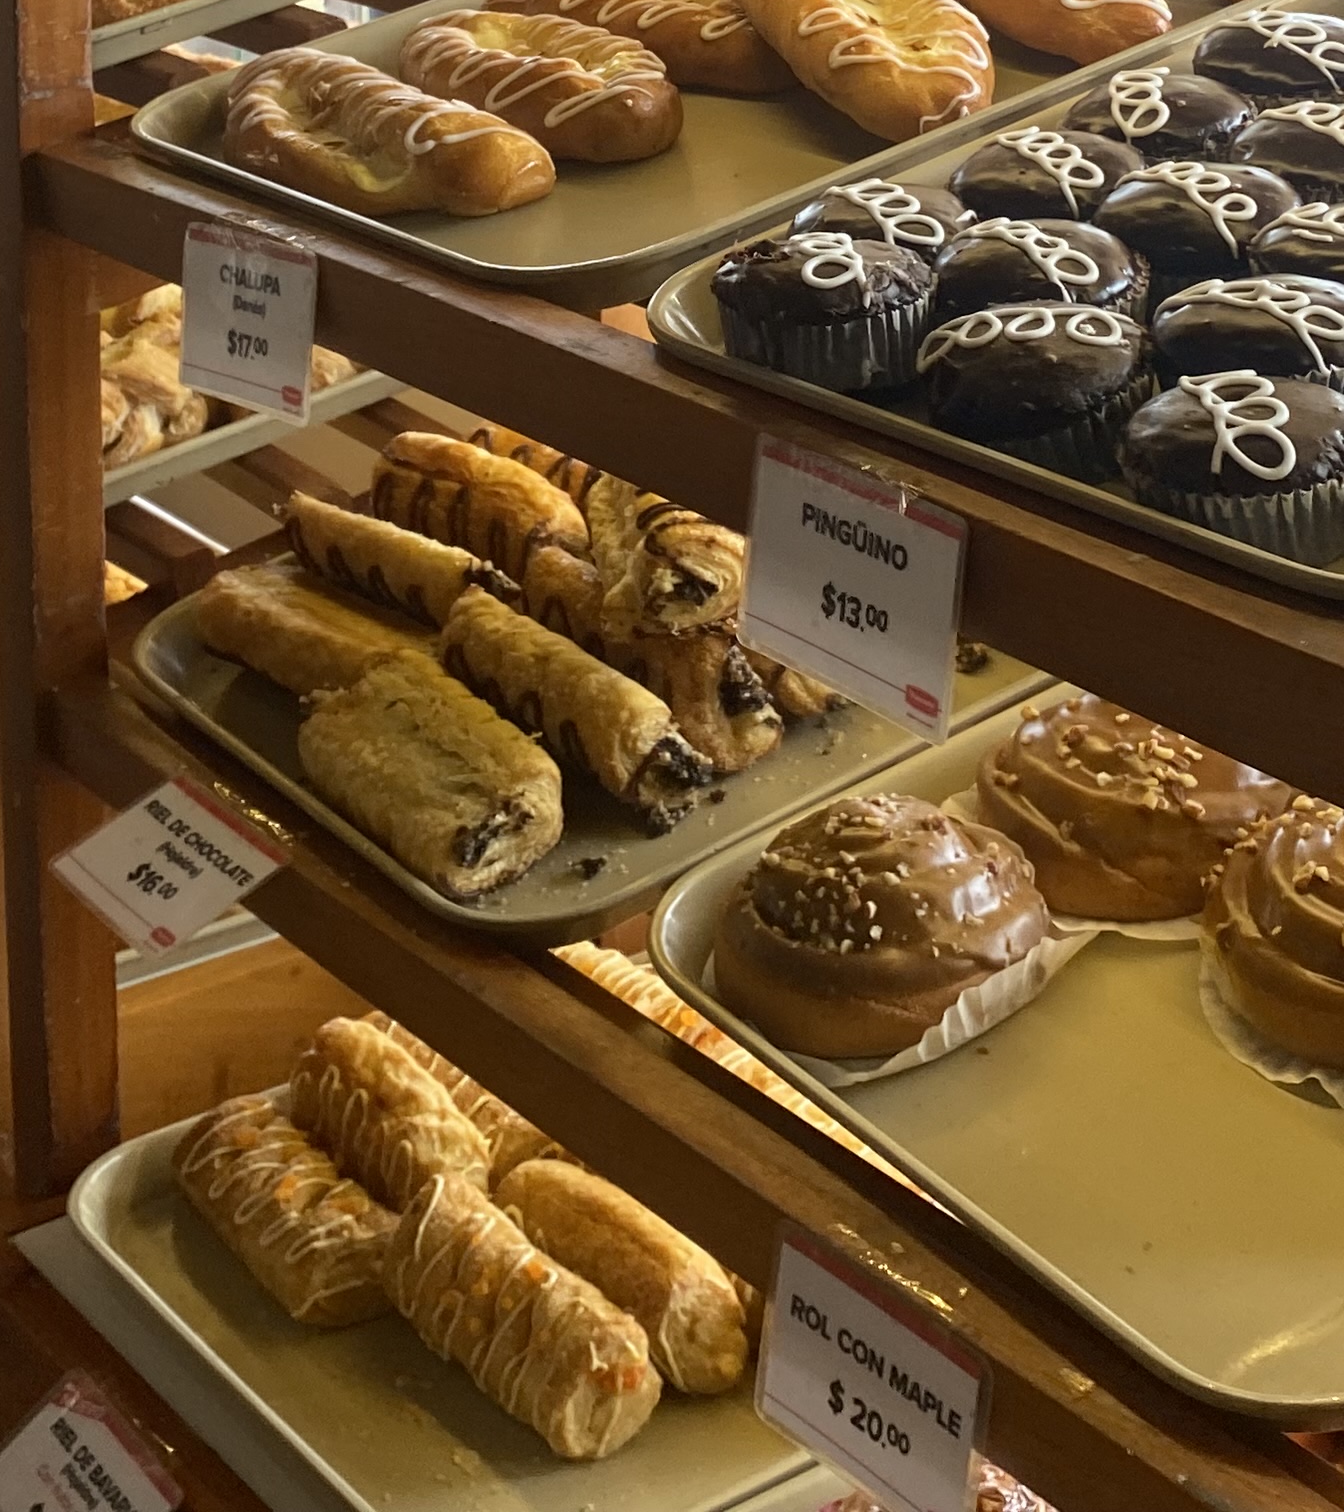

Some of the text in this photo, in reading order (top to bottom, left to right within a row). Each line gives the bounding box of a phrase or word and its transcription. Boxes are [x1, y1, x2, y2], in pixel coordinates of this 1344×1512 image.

[219, 263, 281, 297] CHALUPA
[801, 501, 908, 572] PINGÜINO
[820, 580, 890, 633] $13.00
[143, 799, 256, 888] RIEL DE CHOCOLATE
[790, 1293, 963, 1440] ROL CON MAPLE
[88, 1463, 138, 1512] BAVAR
